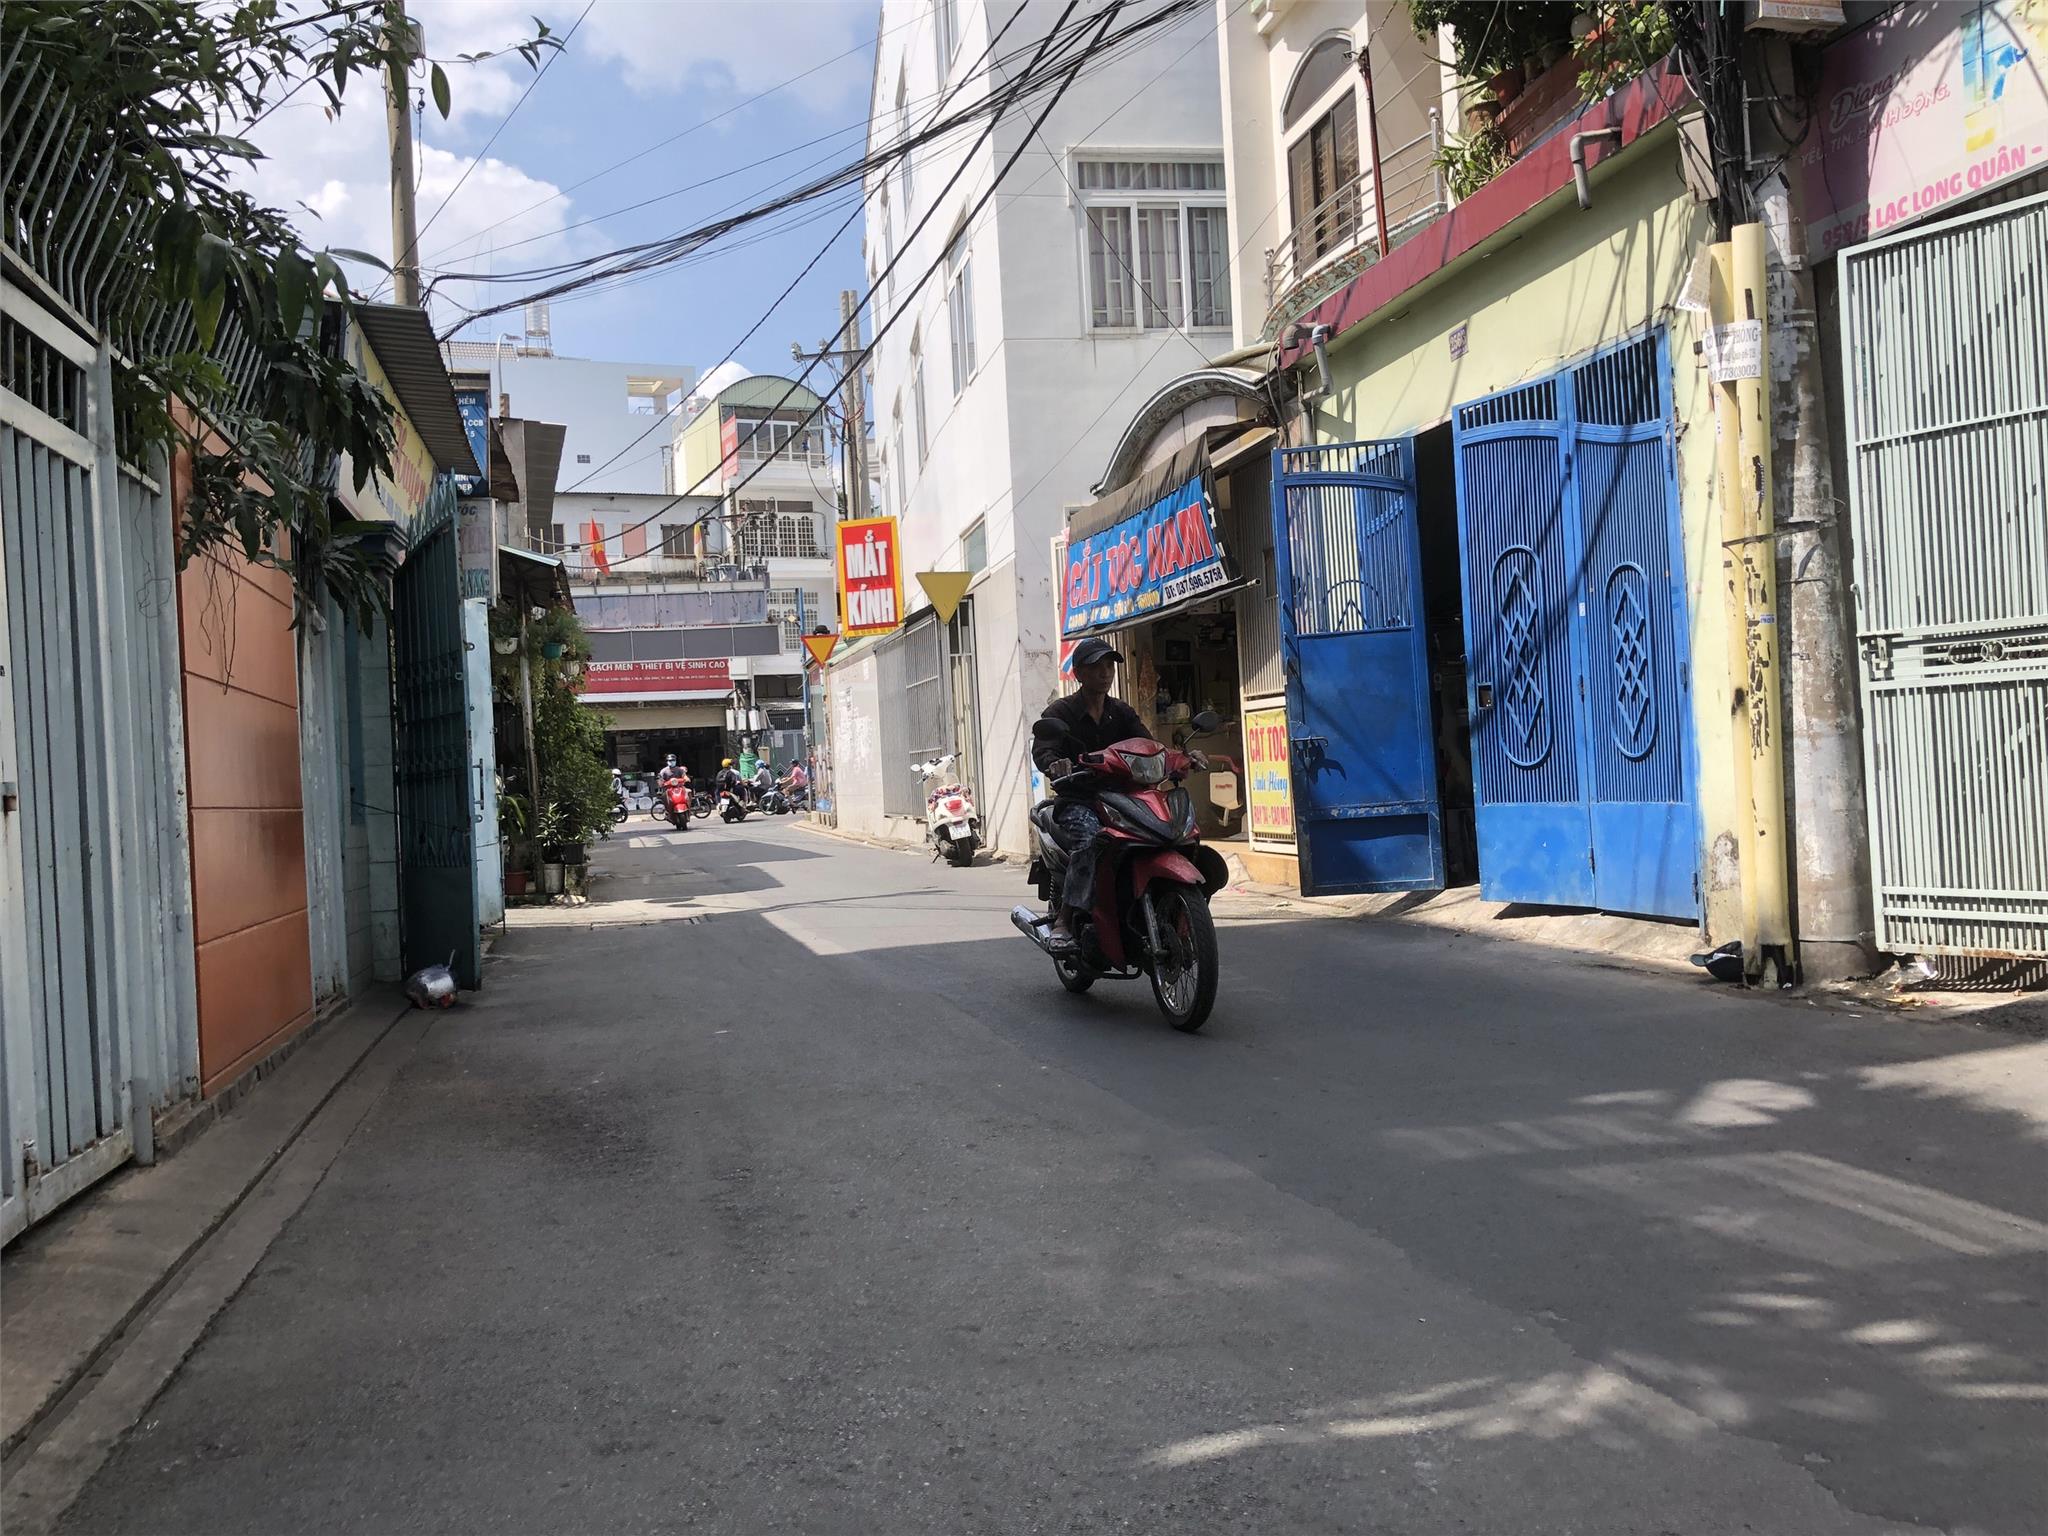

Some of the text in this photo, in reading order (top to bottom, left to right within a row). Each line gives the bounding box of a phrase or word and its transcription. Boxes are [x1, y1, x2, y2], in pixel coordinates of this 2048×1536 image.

[1832, 75, 1895, 131] Diana
[1876, 196, 1909, 228] LẠC
[1912, 171, 1963, 212] LONG
[1966, 144, 2026, 190] QUÂN
[1106, 530, 1143, 596] TÓC
[1146, 501, 1216, 582] NAM
[847, 584, 896, 626] KÍNH
[1176, 566, 1224, 596] 037.996.5758
[665, 662, 674, 671] BỊ
[687, 660, 707, 669] SINH
[708, 659, 726, 668] CAO
